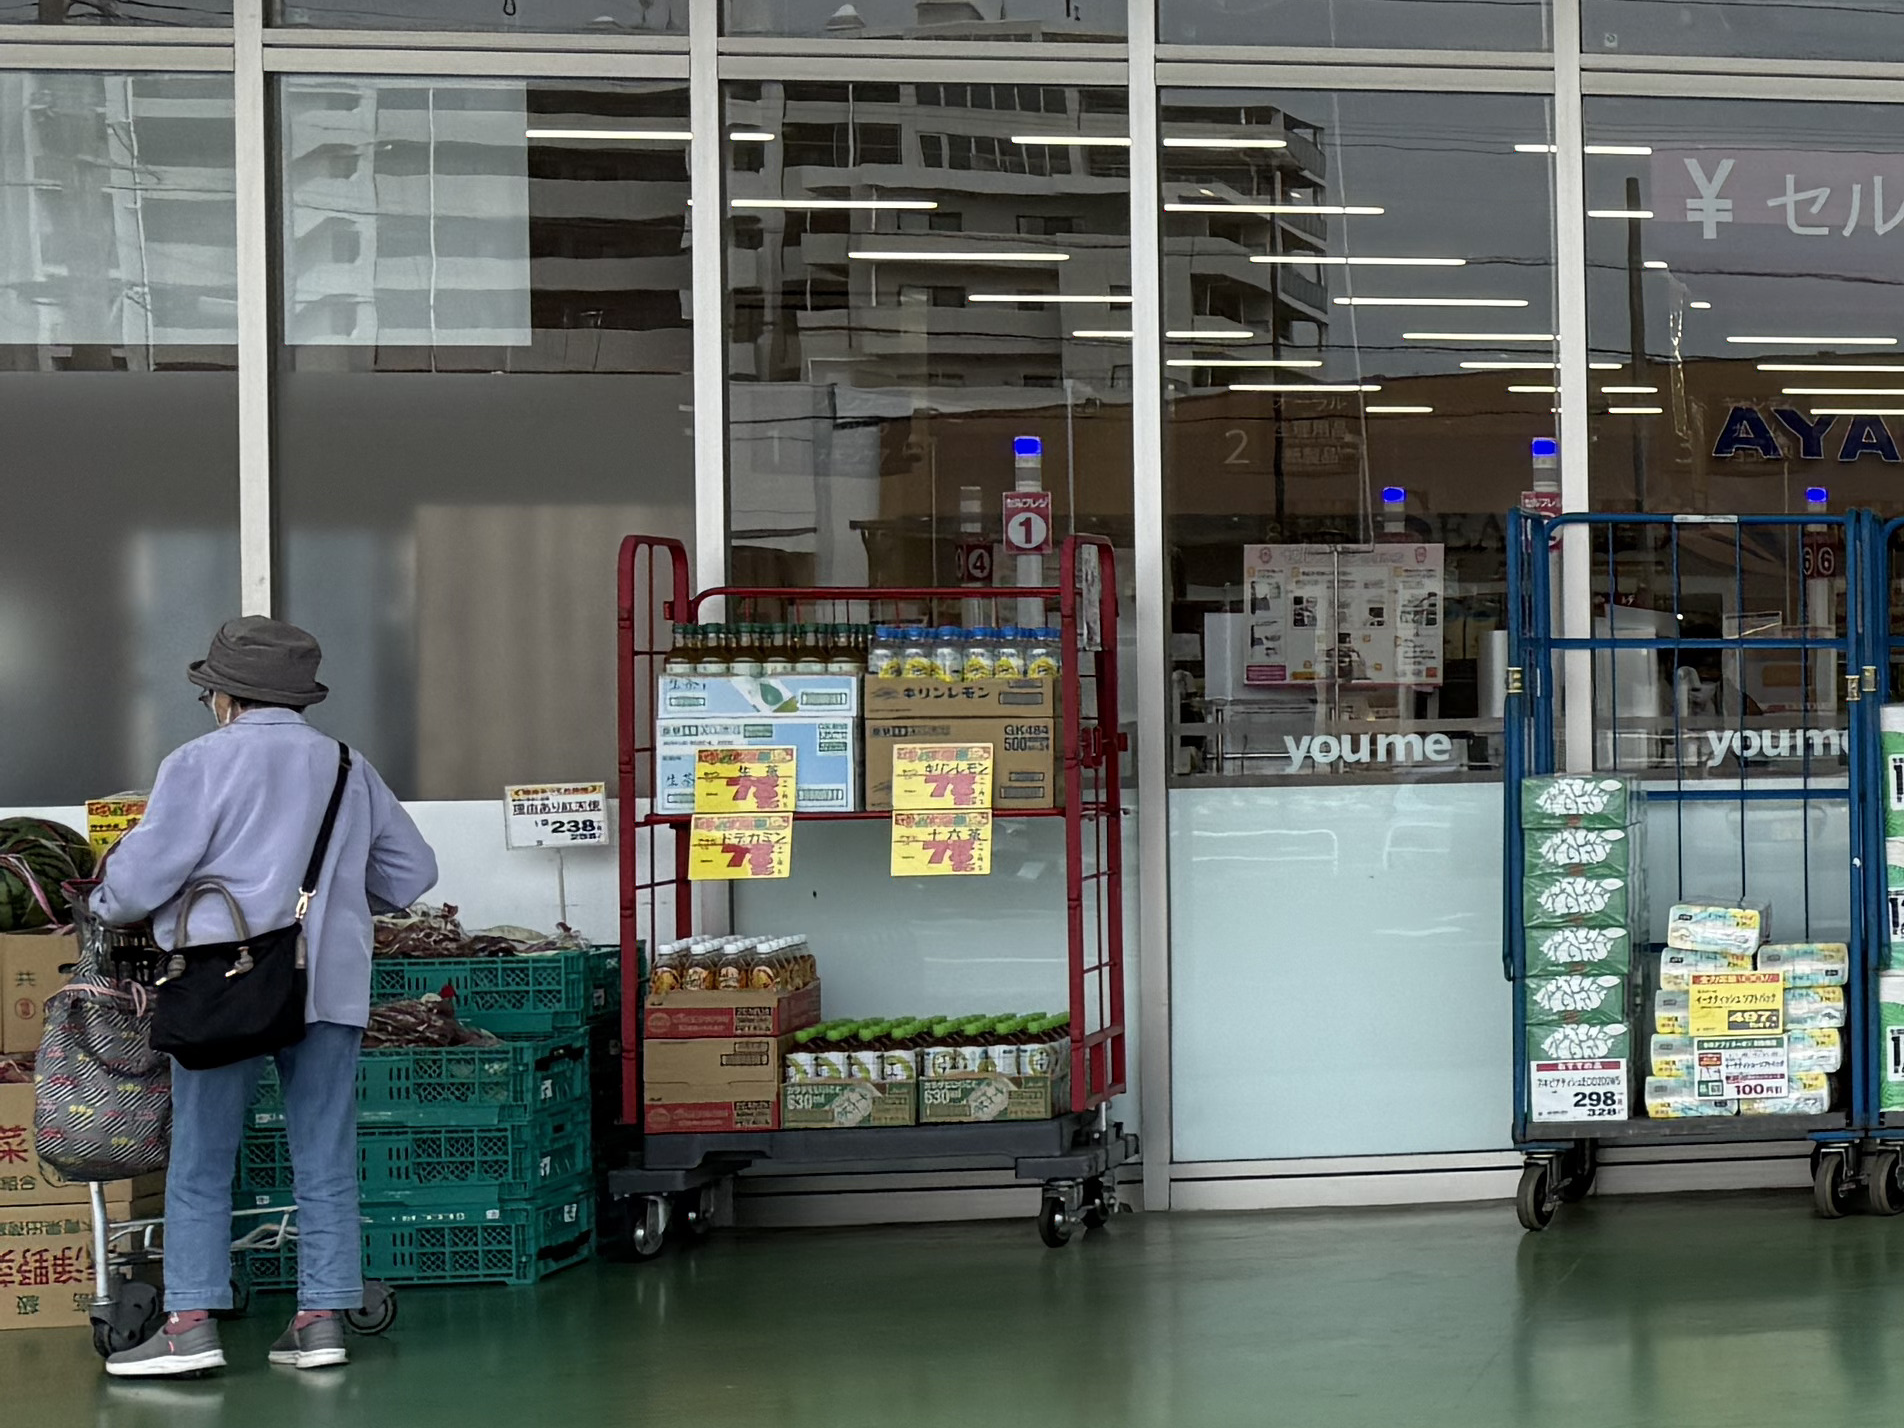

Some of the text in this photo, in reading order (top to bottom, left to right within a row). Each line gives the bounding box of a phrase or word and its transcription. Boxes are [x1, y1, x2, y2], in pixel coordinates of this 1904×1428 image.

[1018, 516, 1033, 545] 1
[903, 686, 990, 700] キリンレモン
[1706, 728, 1849, 768] youm
[551, 819, 595, 833] 238
[1730, 1010, 1771, 1024] 497
[1573, 1091, 1617, 1108] 298
